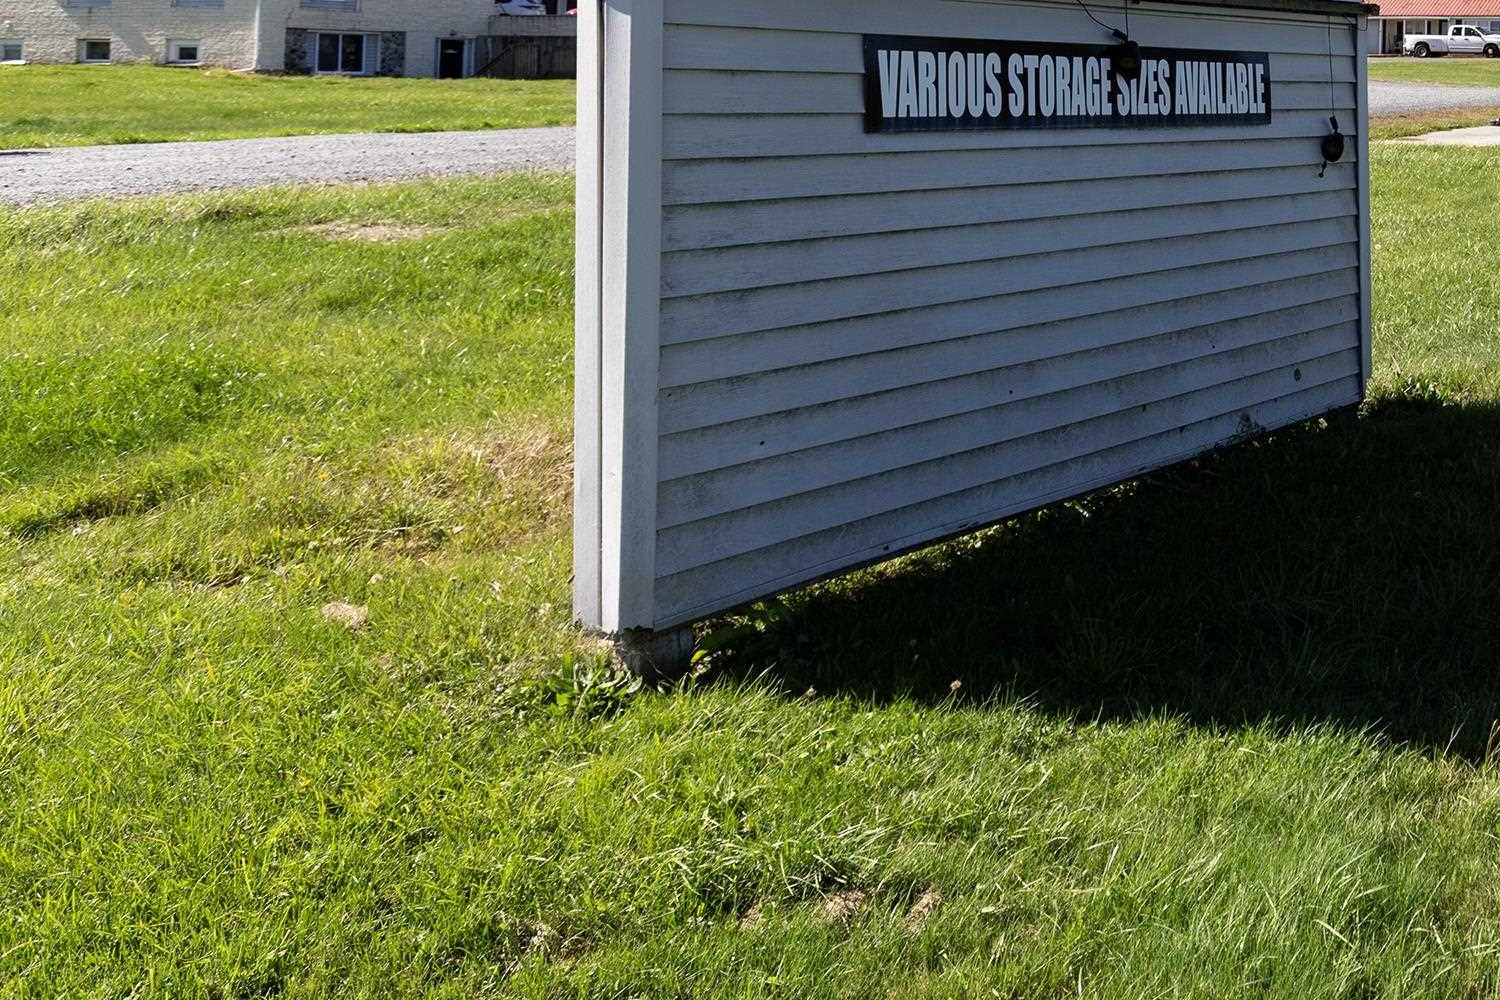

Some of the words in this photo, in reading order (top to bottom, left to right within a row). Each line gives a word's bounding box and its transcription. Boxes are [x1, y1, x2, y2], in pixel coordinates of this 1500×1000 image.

[877, 49, 1001, 119] VARIOUS
[1007, 52, 1113, 118] STORAGE
[1175, 60, 1266, 115] AVAILABLE
